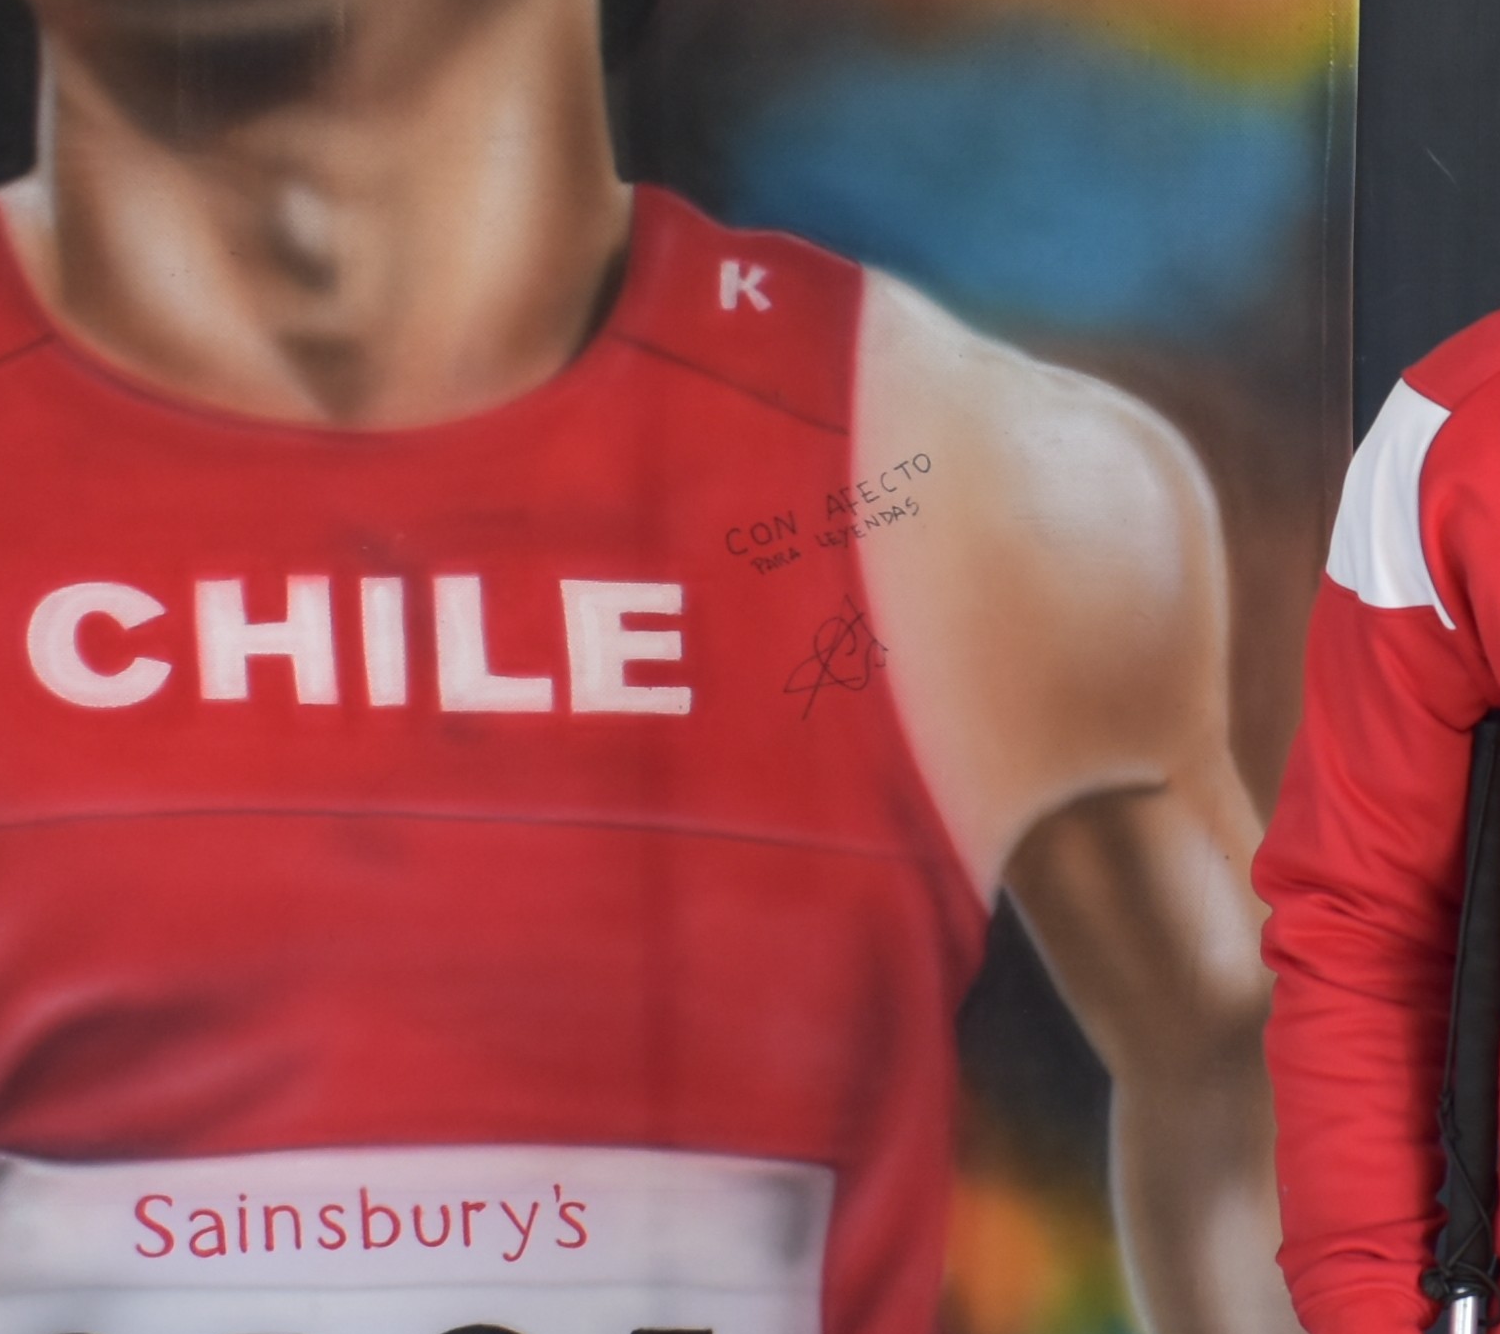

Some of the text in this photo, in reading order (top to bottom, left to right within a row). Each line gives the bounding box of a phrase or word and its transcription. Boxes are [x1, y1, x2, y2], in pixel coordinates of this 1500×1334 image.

[719, 257, 774, 313] K
[725, 452, 932, 555] CON AFECTO
[26, 573, 693, 716] CHILE
[132, 1184, 589, 1264] Sainsbury's
